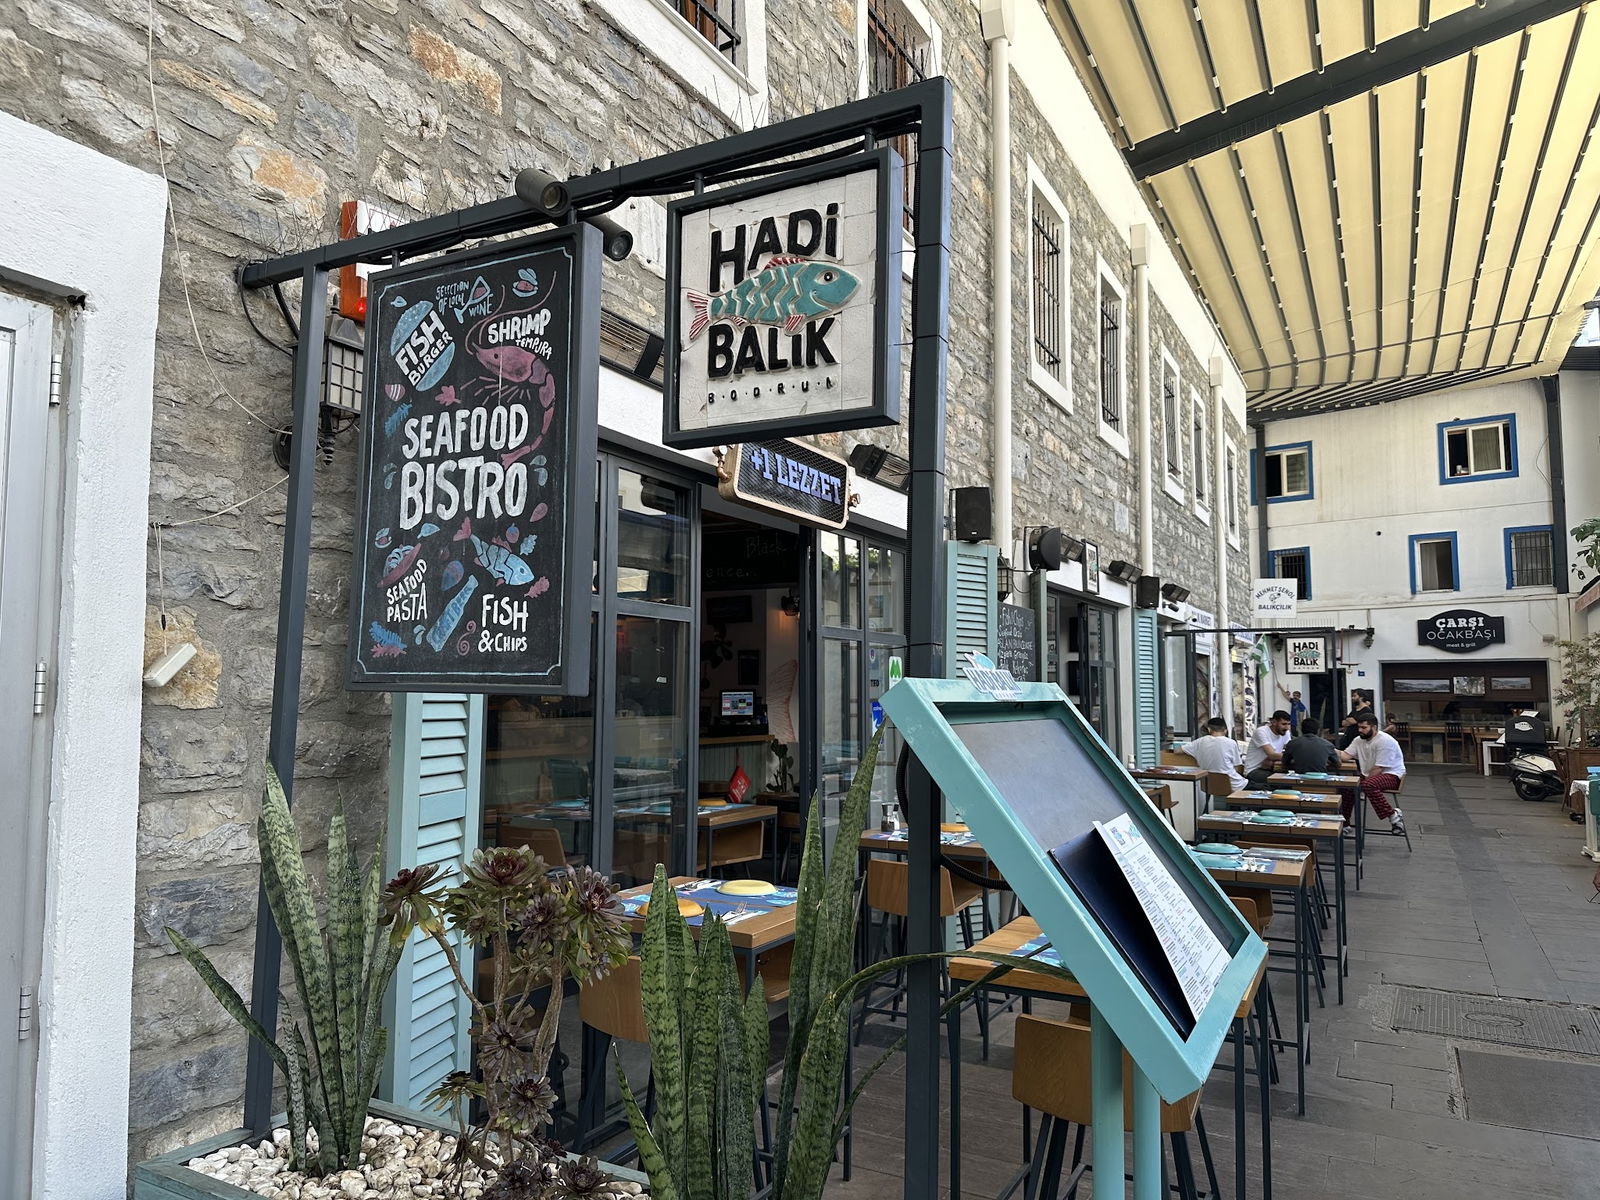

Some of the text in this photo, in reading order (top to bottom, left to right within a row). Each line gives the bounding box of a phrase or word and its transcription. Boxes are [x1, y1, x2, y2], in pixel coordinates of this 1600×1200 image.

[438, 292, 466, 316] OF LOCAL
[468, 293, 494, 317] WINE
[395, 310, 446, 376] FISH
[487, 308, 552, 344] SHRIMP
[407, 330, 453, 387] BURGER
[515, 337, 553, 361] TEMPURA
[401, 403, 529, 459] SEAFOOD
[400, 455, 528, 530] BISTRO
[751, 447, 842, 505] +1 LEZZET
[386, 558, 428, 605] SEAFOOD
[1255, 586, 1278, 599] MEHMET
[386, 582, 428, 623] PASTA
[481, 593, 529, 633] FISH
[1426, 629, 1497, 641] OCAKBAŞI
[1435, 616, 1485, 631] ÇARŞI
